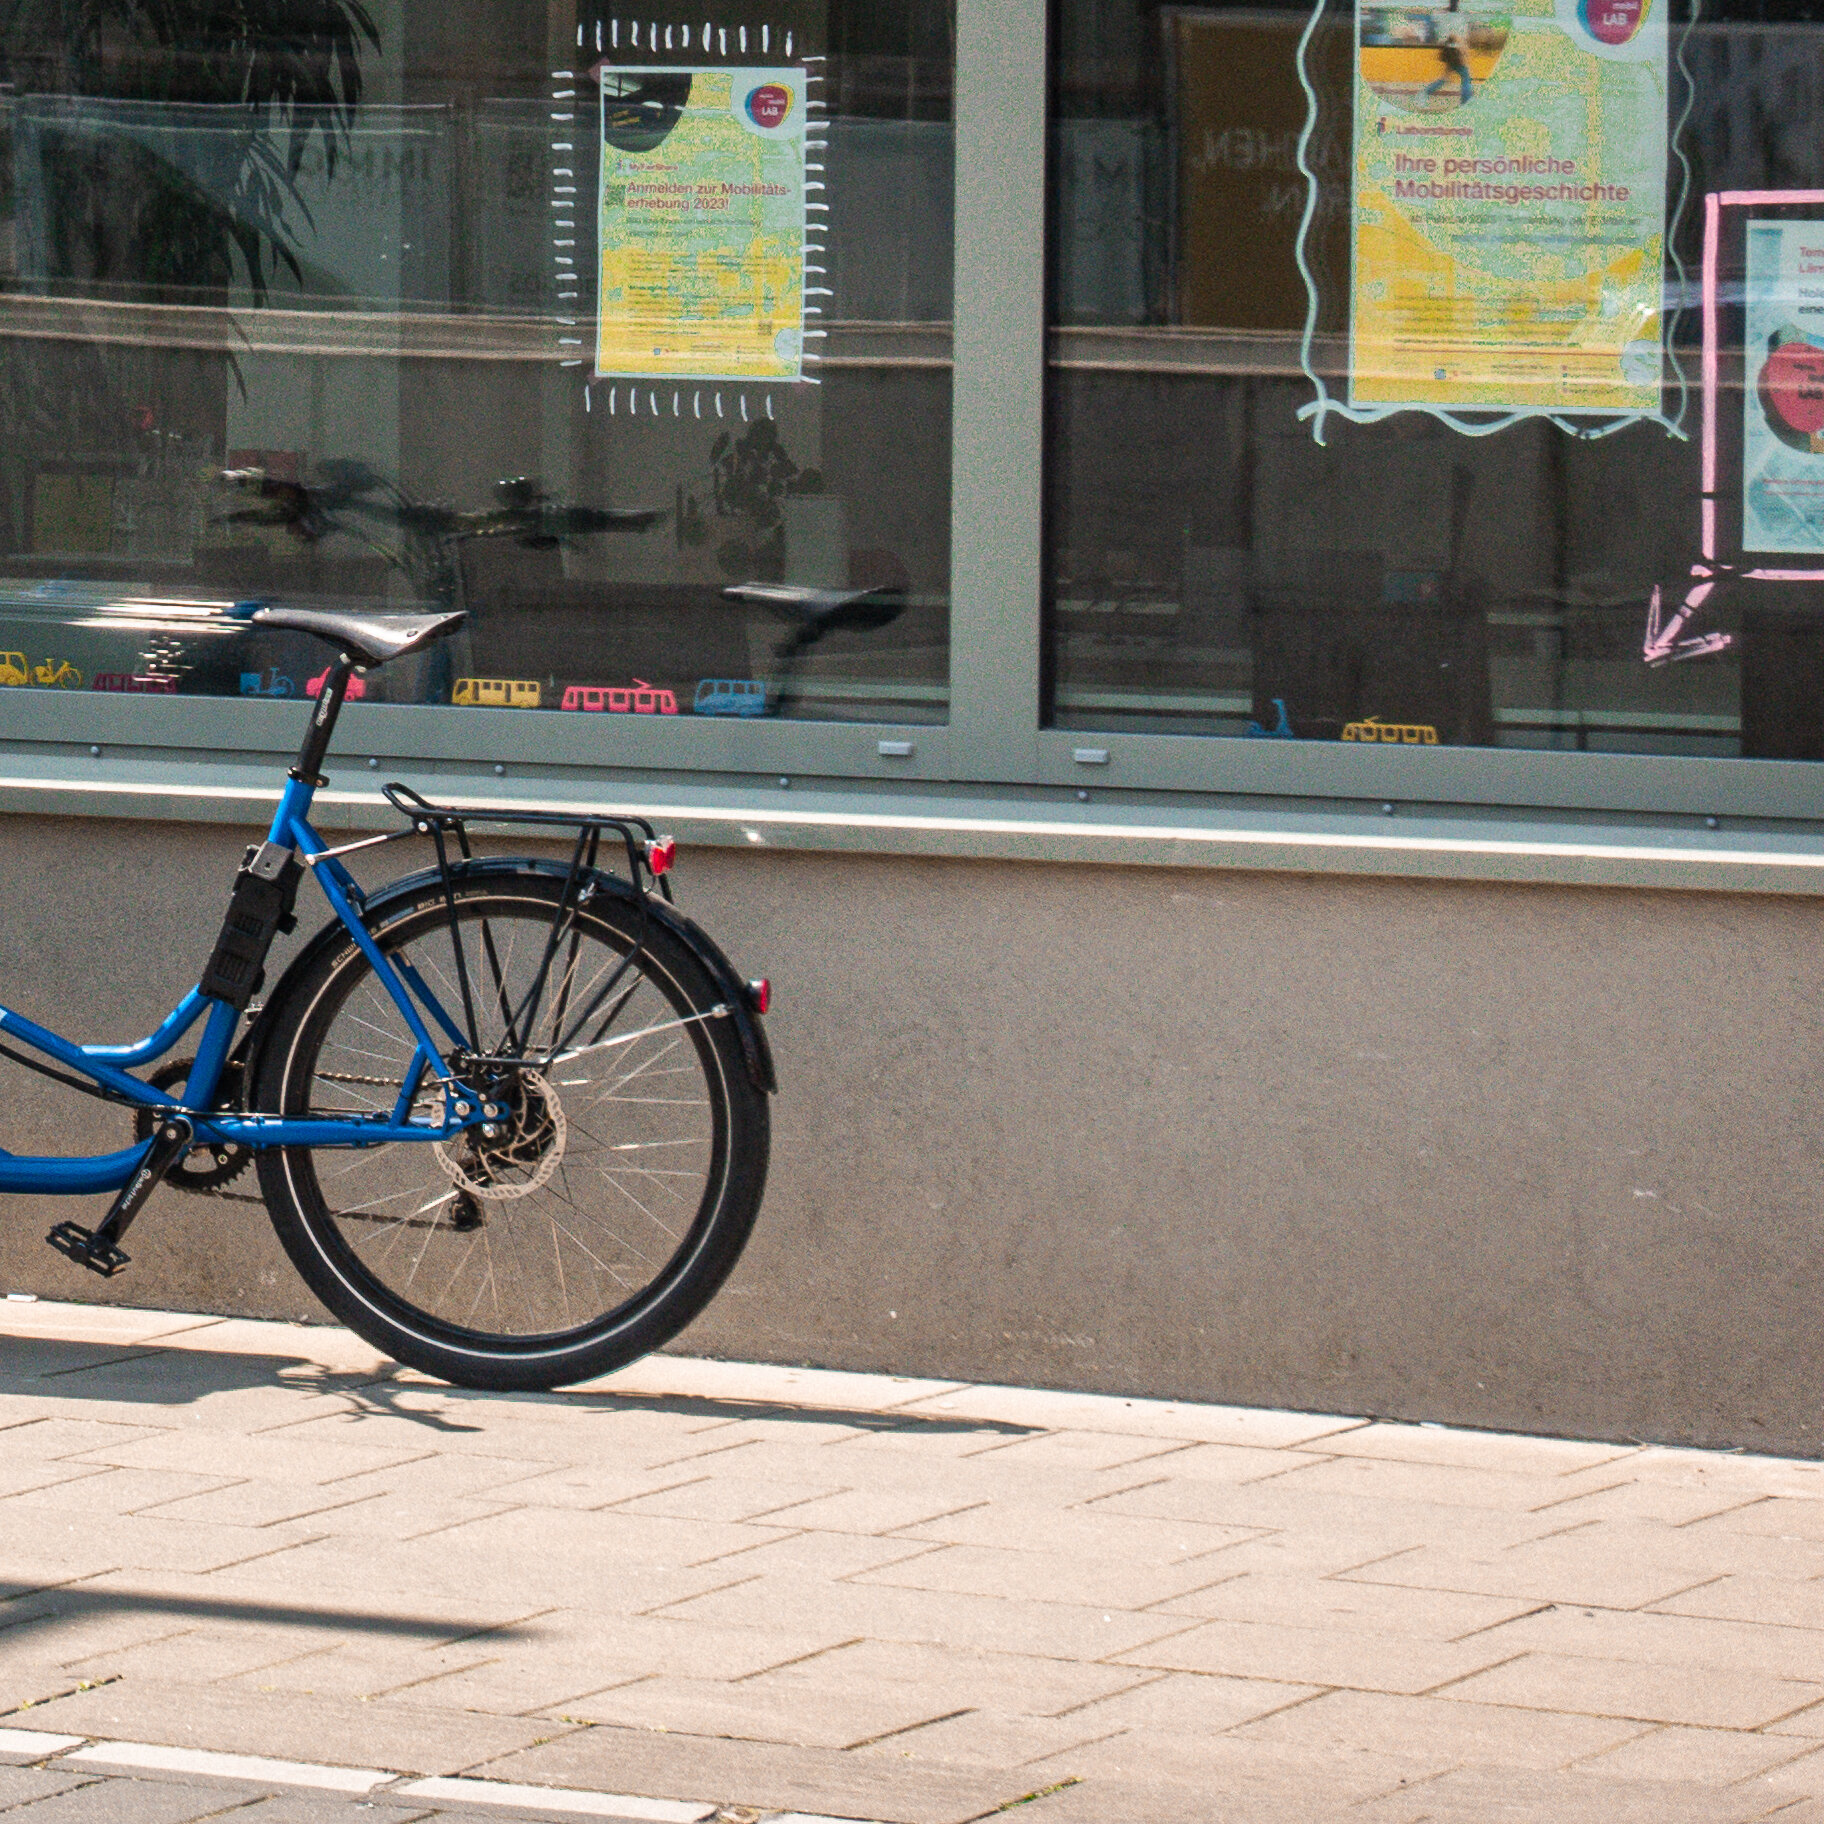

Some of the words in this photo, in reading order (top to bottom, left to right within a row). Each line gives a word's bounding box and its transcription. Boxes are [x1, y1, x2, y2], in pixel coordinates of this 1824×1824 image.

[1602, 12, 1628, 26] LAB
[1395, 153, 1437, 173] Ihre
[1444, 155, 1576, 177] persönliche
[627, 181, 693, 195] Anmelden
[697, 184, 718, 195] zur
[721, 183, 792, 196] Mobilitäts-
[1394, 179, 1631, 205] Mobilitätsgeschichte
[627, 197, 690, 212] erhebung
[694, 197, 730, 211] 2023!
